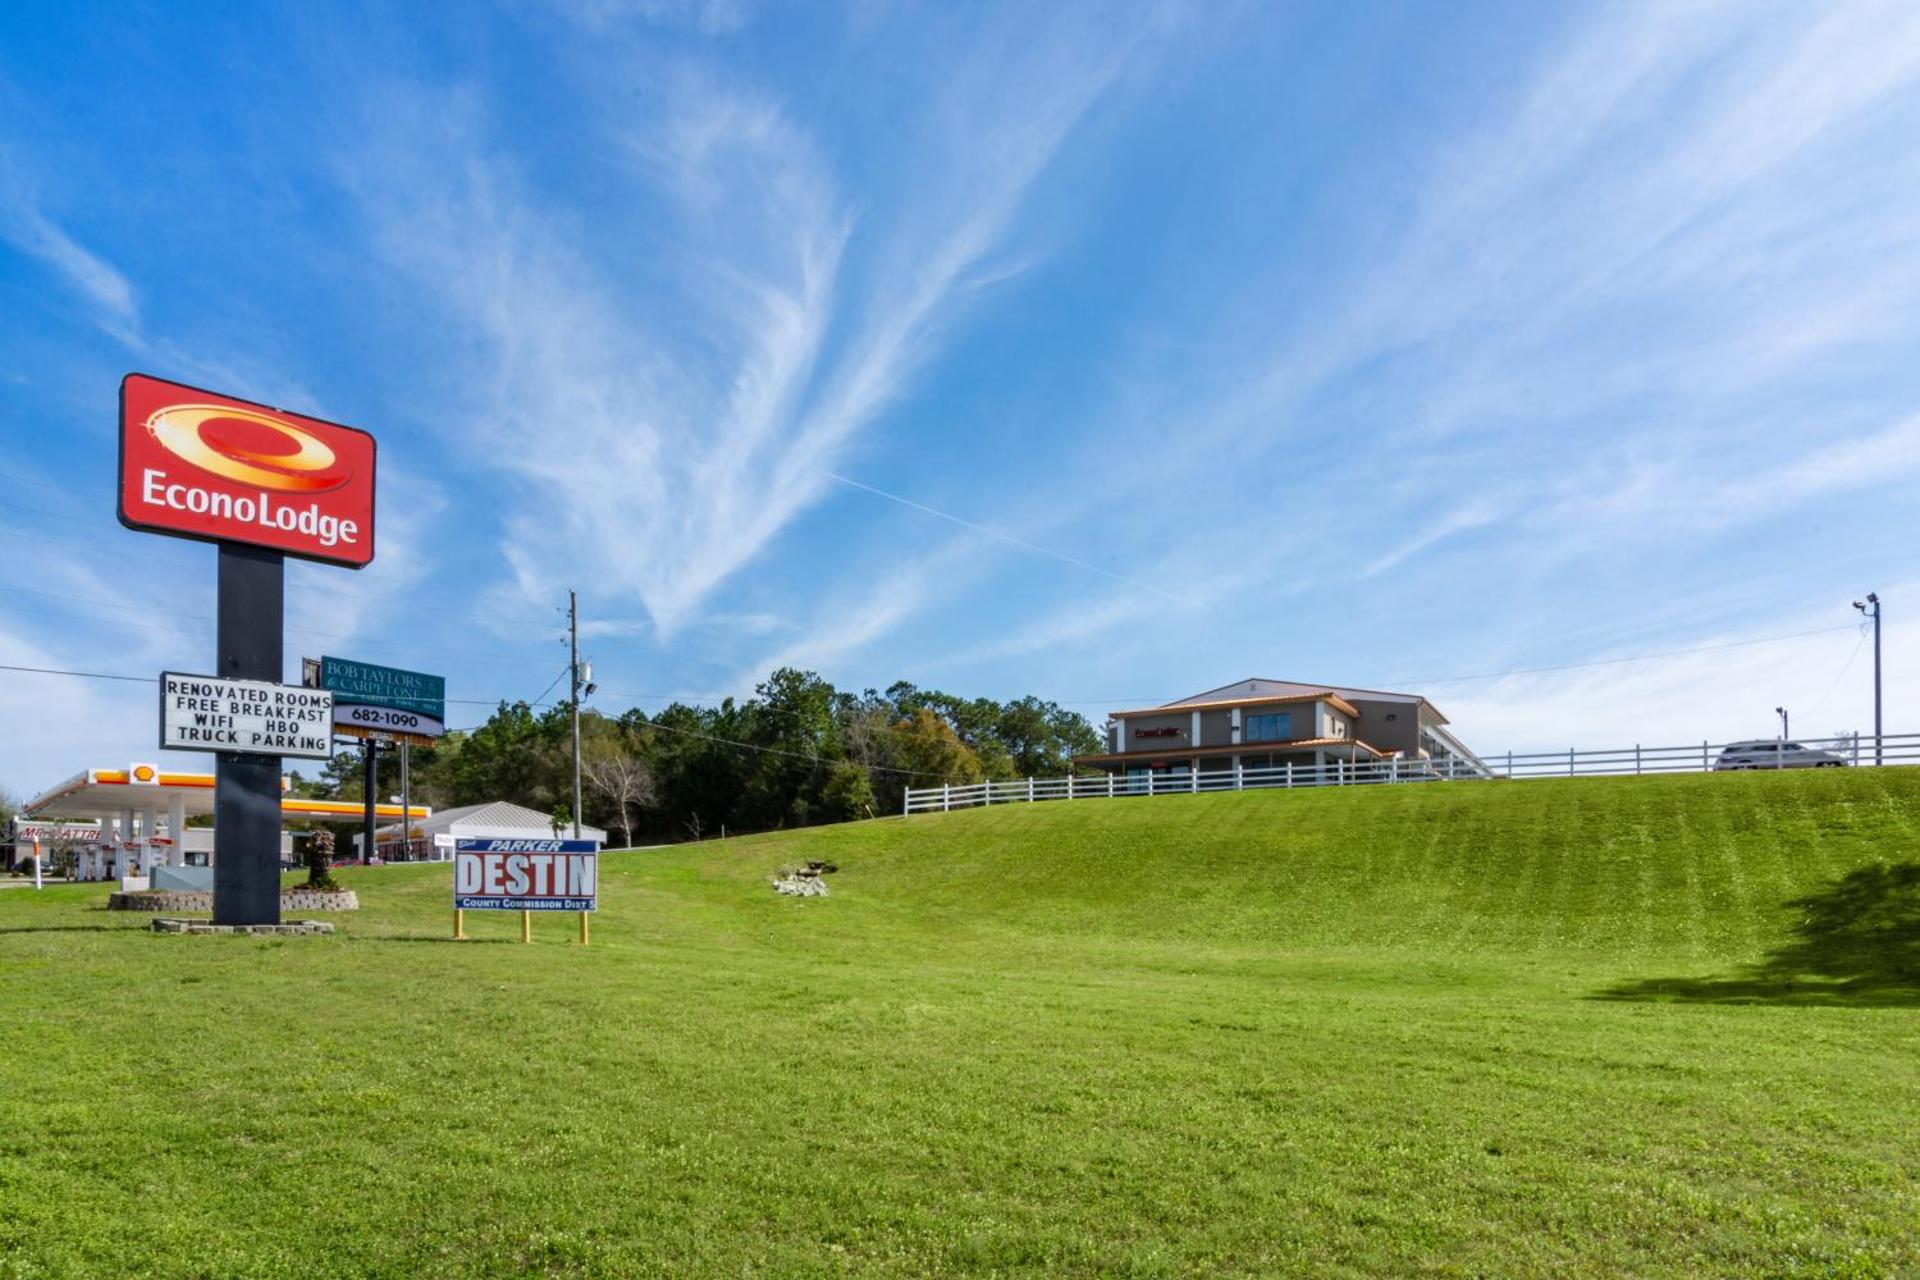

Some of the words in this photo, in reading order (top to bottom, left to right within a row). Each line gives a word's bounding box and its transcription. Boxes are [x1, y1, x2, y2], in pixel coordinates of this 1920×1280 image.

[328, 661, 358, 678] BOB
[360, 667, 422, 688] TAYLORS
[168, 681, 268, 702] RENOVATED
[275, 693, 331, 708] ROOMS
[177, 697, 219, 712] FREE
[231, 703, 325, 722] BREAKFAST
[352, 709, 418, 727] 682-1090
[195, 713, 233, 728] WIFI
[266, 722, 300, 733] HBO
[178, 726, 238, 743] TRUCK
[252, 733, 326, 750] PARKING
[488, 840, 564, 851] PARKER
[457, 854, 595, 896] DESTIN
